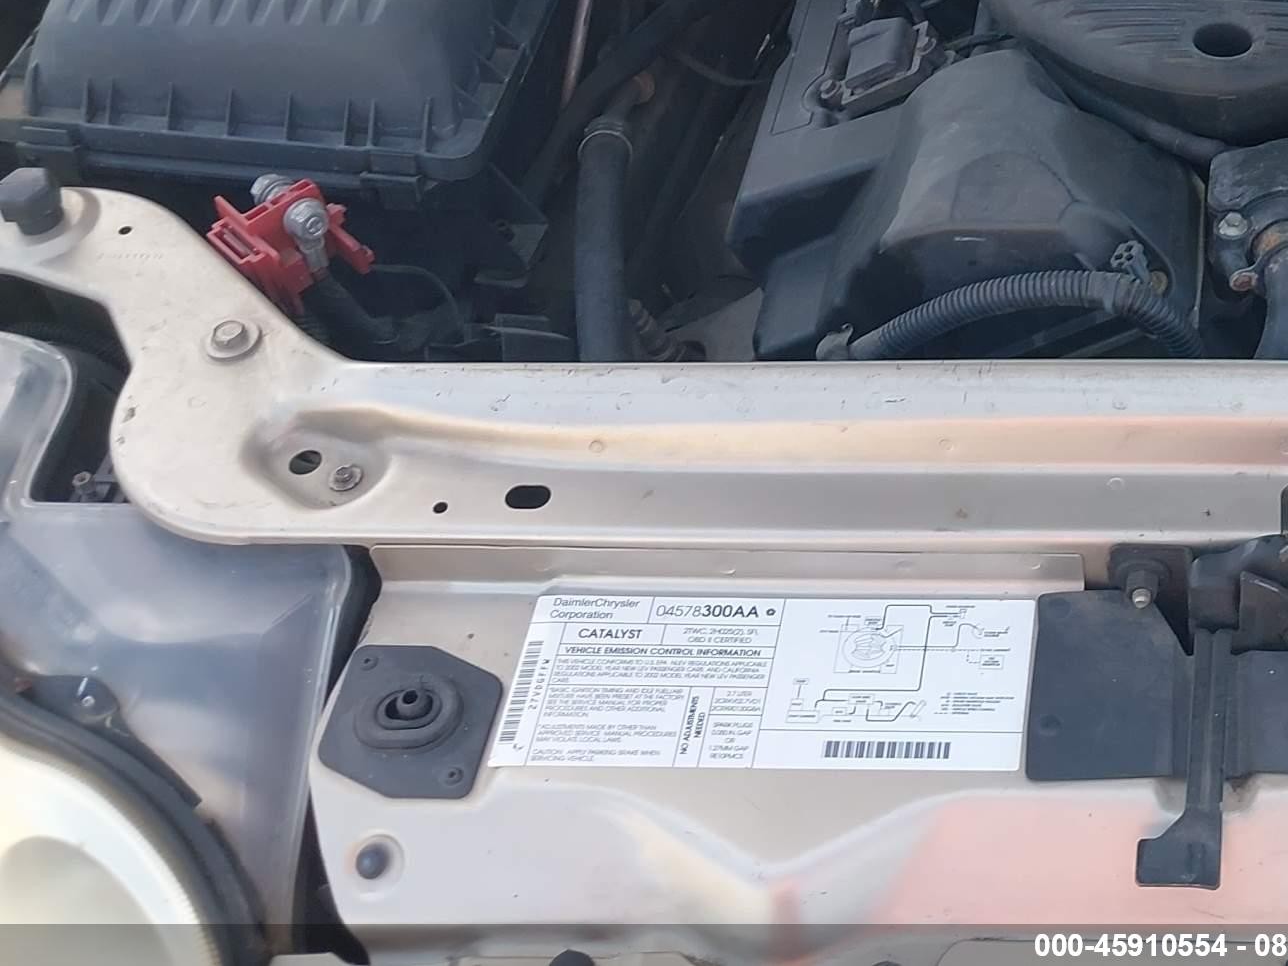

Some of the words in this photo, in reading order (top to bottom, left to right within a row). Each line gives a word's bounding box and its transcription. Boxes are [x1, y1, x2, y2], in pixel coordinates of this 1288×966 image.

[551, 597, 641, 609] DaimlerChrysler
[548, 609, 614, 620] Corporation
[655, 604, 760, 618] 04578300AA
[576, 628, 643, 639] CATALYST
[603, 647, 648, 655] EMISSION
[682, 695, 699, 740] ADJUSTMENTS
[679, 742, 689, 754] NO
